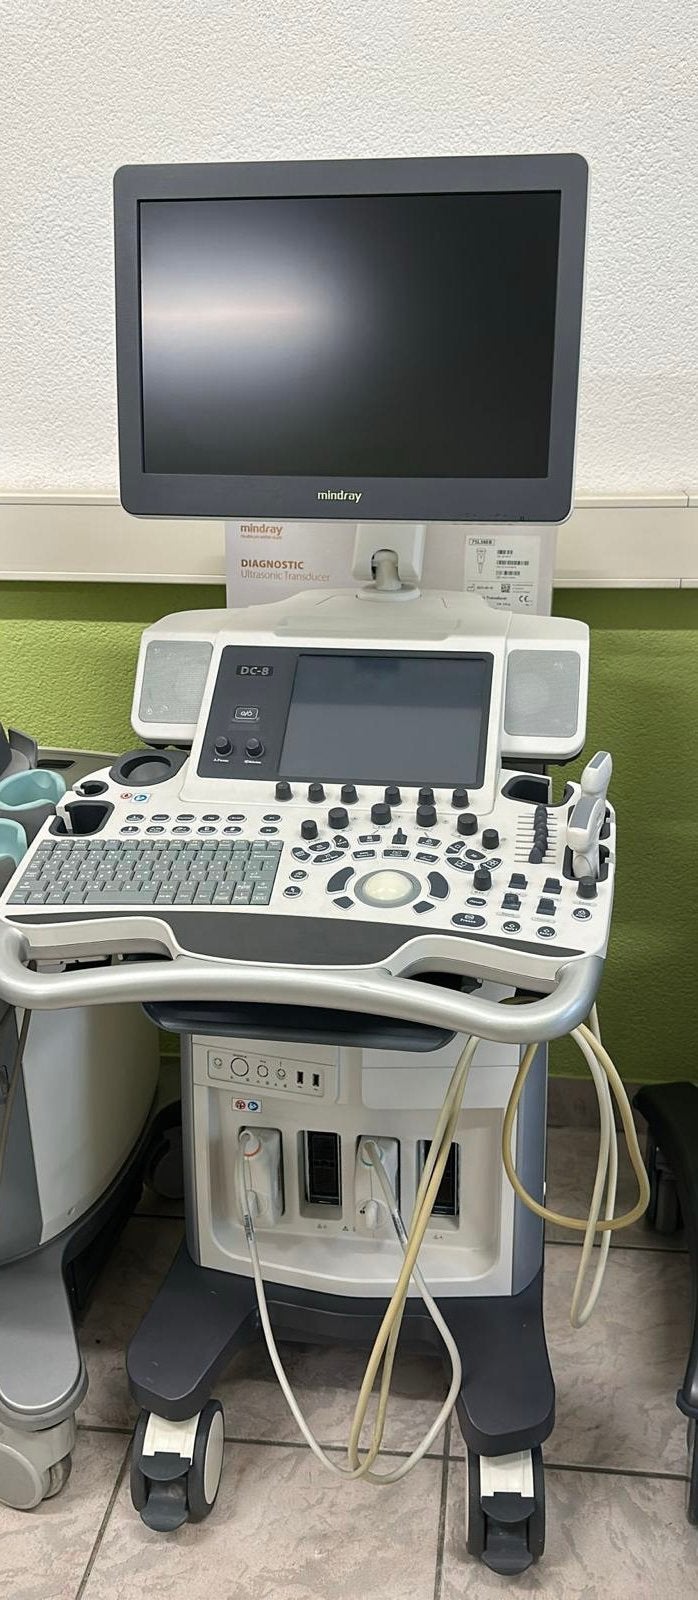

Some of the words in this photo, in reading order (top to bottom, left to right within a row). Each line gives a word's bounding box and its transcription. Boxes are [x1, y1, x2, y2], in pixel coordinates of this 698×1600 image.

[317, 490, 362, 503] mindray
[240, 523, 283, 536] mindray
[241, 559, 304, 570] DIAGNOSTIC
[241, 570, 283, 581] Ultrasonic
[285, 571, 330, 582] Transducer
[240, 666, 270, 675] DC-8
